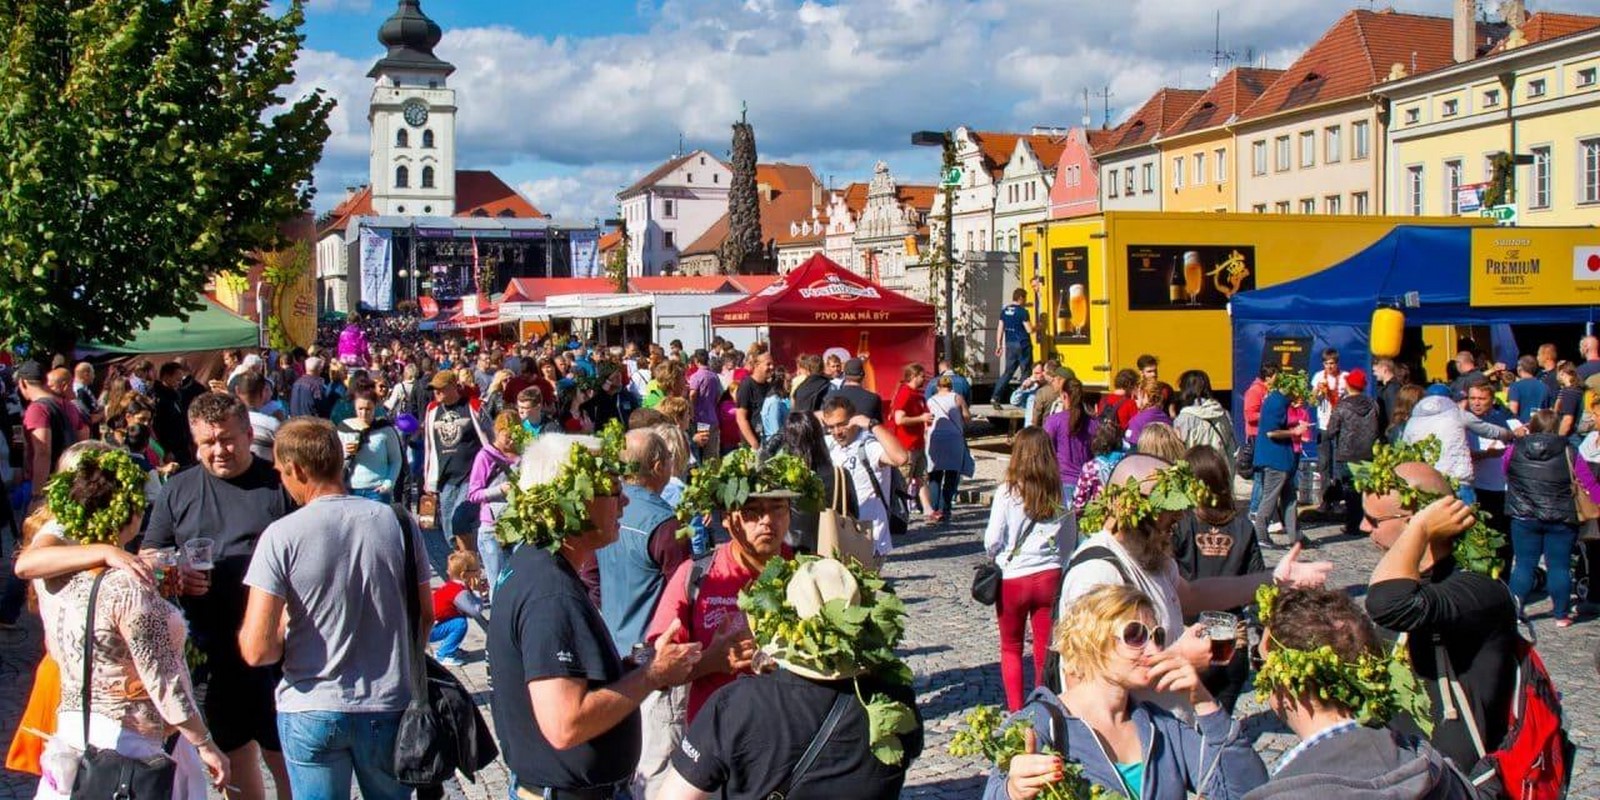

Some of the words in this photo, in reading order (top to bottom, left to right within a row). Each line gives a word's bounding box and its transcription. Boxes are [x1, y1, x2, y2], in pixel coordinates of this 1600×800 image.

[1482, 208, 1506, 220] EXIT
[1486, 258, 1540, 275] PREMIUM
[815, 311, 838, 320] PIVO
[840, 311, 857, 320] JAK
